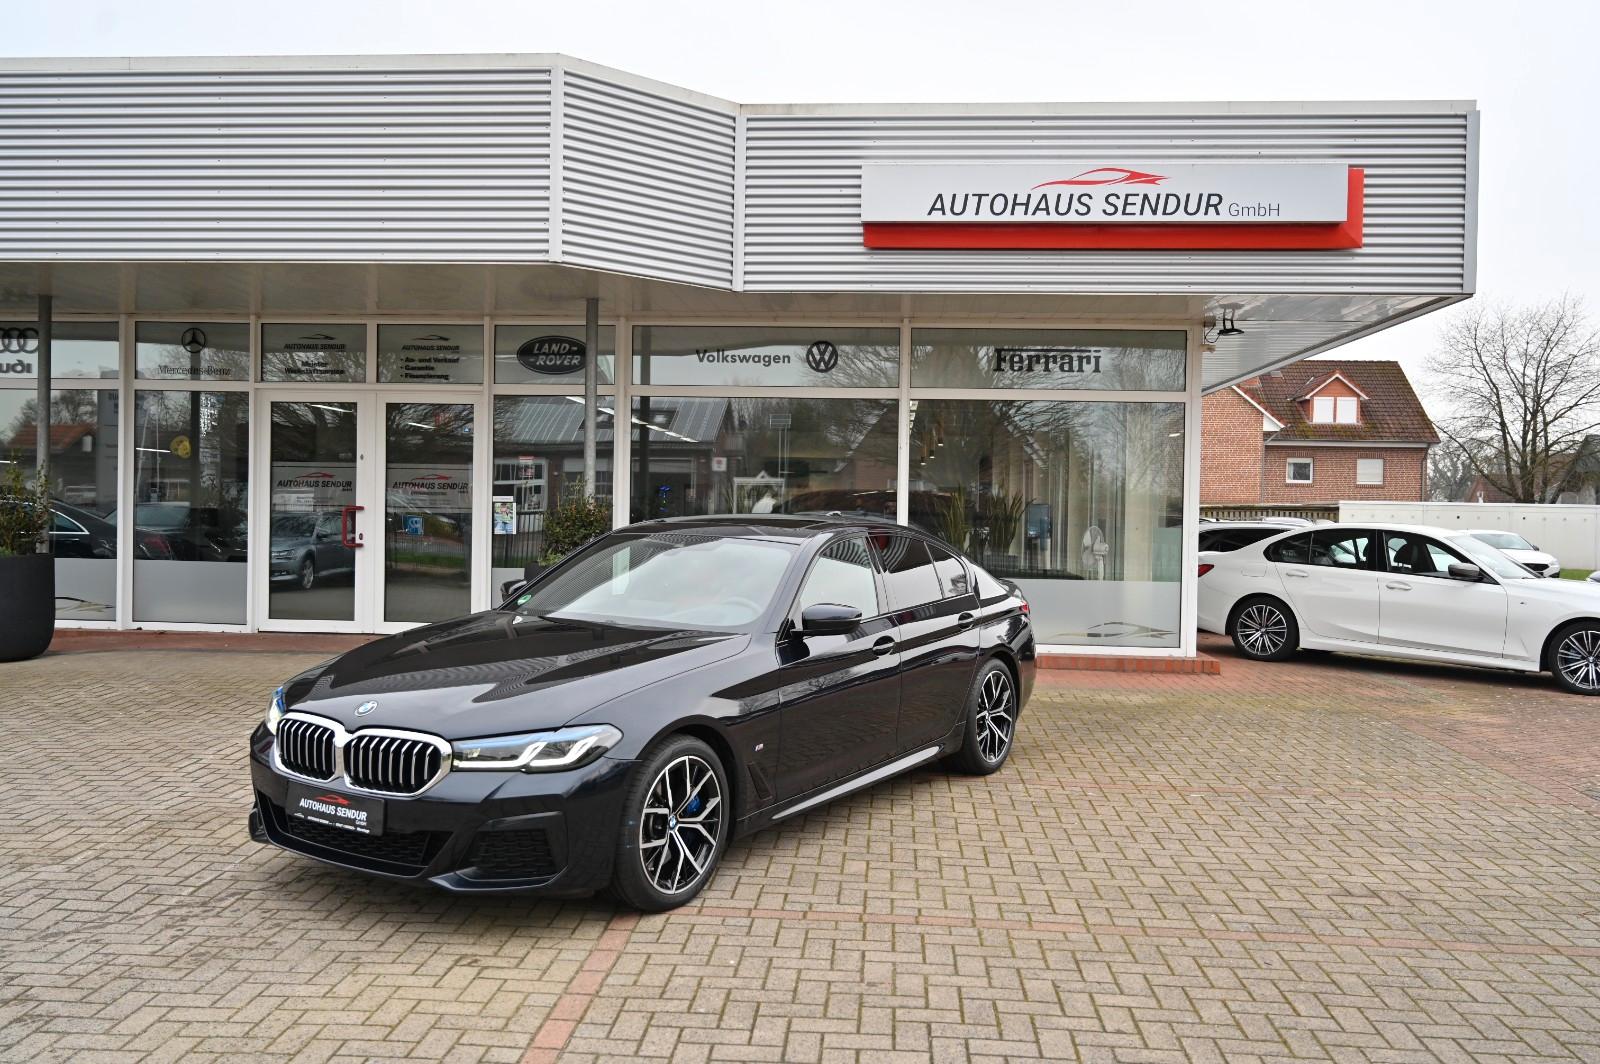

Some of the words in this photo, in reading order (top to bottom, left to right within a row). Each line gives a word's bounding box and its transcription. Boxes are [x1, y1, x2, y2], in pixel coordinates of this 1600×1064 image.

[927, 193, 1093, 217] AUTOHAUS
[1102, 193, 1223, 217] SENDUR
[1228, 202, 1281, 217] GmbH
[0, 359, 33, 374] udi
[696, 349, 791, 367] Volkswagen
[993, 348, 1102, 373] Ferrari
[277, 480, 320, 488] AUTOHAUS
[393, 482, 435, 490] AUTOHAUS
[437, 482, 469, 490] SENDUR
[299, 798, 336, 815] AUTOHAUS
[336, 806, 368, 821] SENDUR
